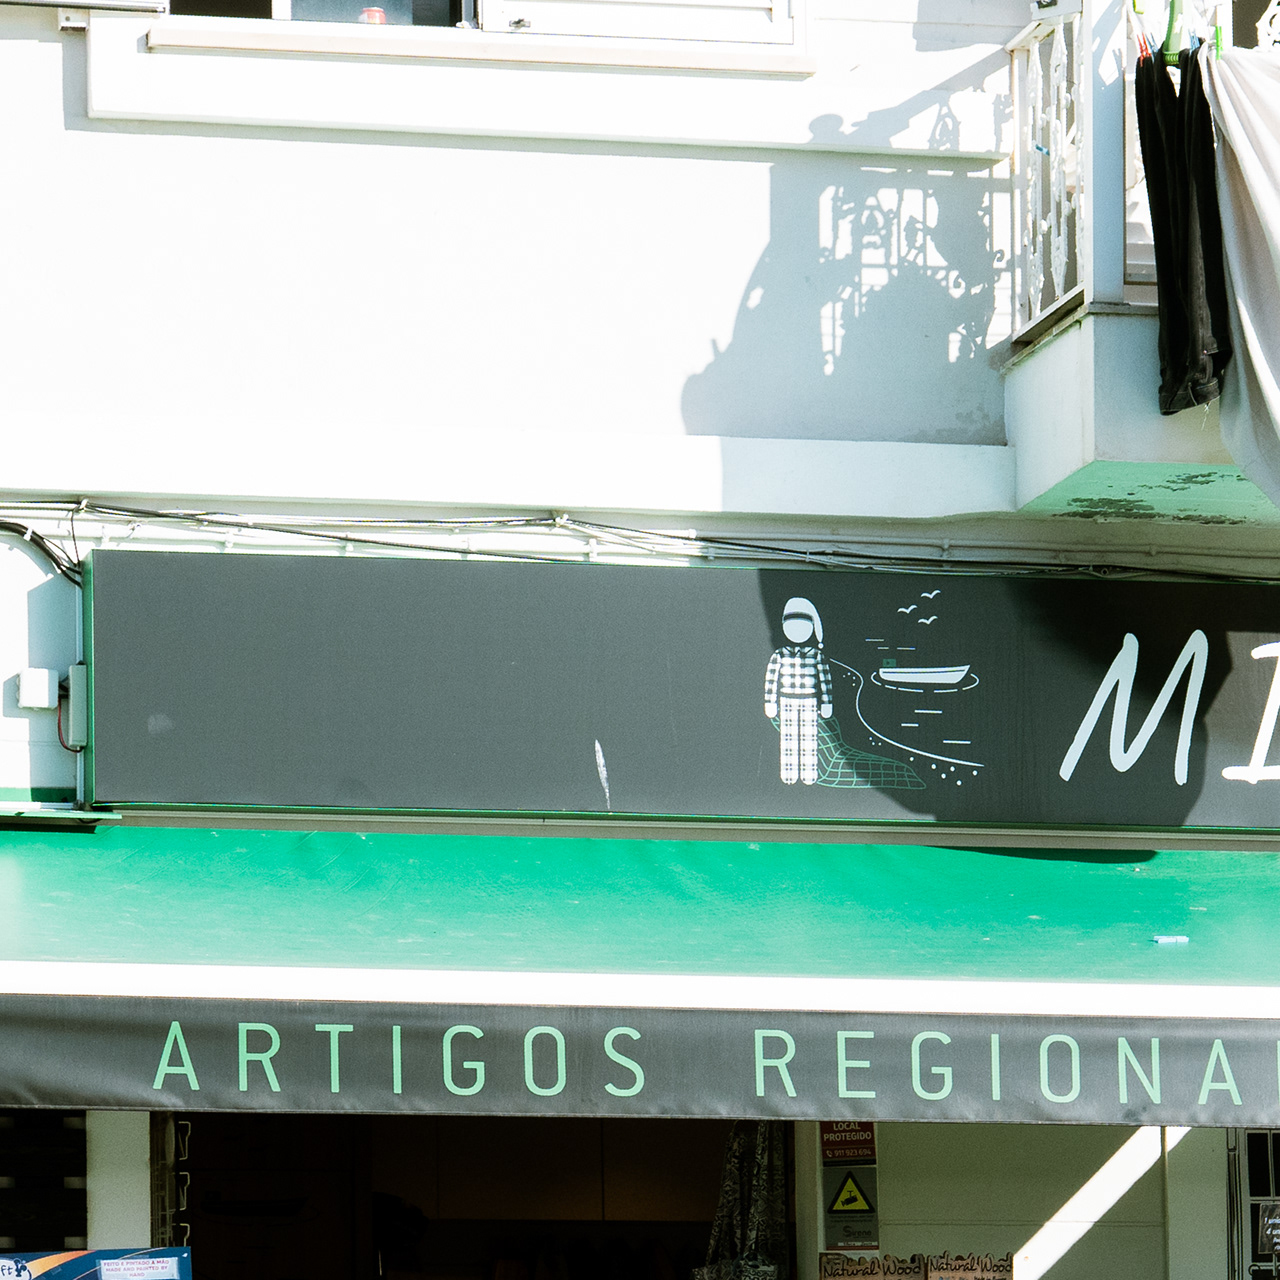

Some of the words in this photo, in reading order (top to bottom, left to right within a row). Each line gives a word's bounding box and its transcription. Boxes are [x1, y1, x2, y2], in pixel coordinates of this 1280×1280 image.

[152, 1020, 645, 1097] ARTIGOS
[833, 1121, 861, 1131] LOCAL
[823, 1131, 872, 1141] PROTEGIDO
[834, 1149, 845, 1157] 911
[823, 1260, 878, 1279] Natural
[929, 1257, 977, 1273] Natural
